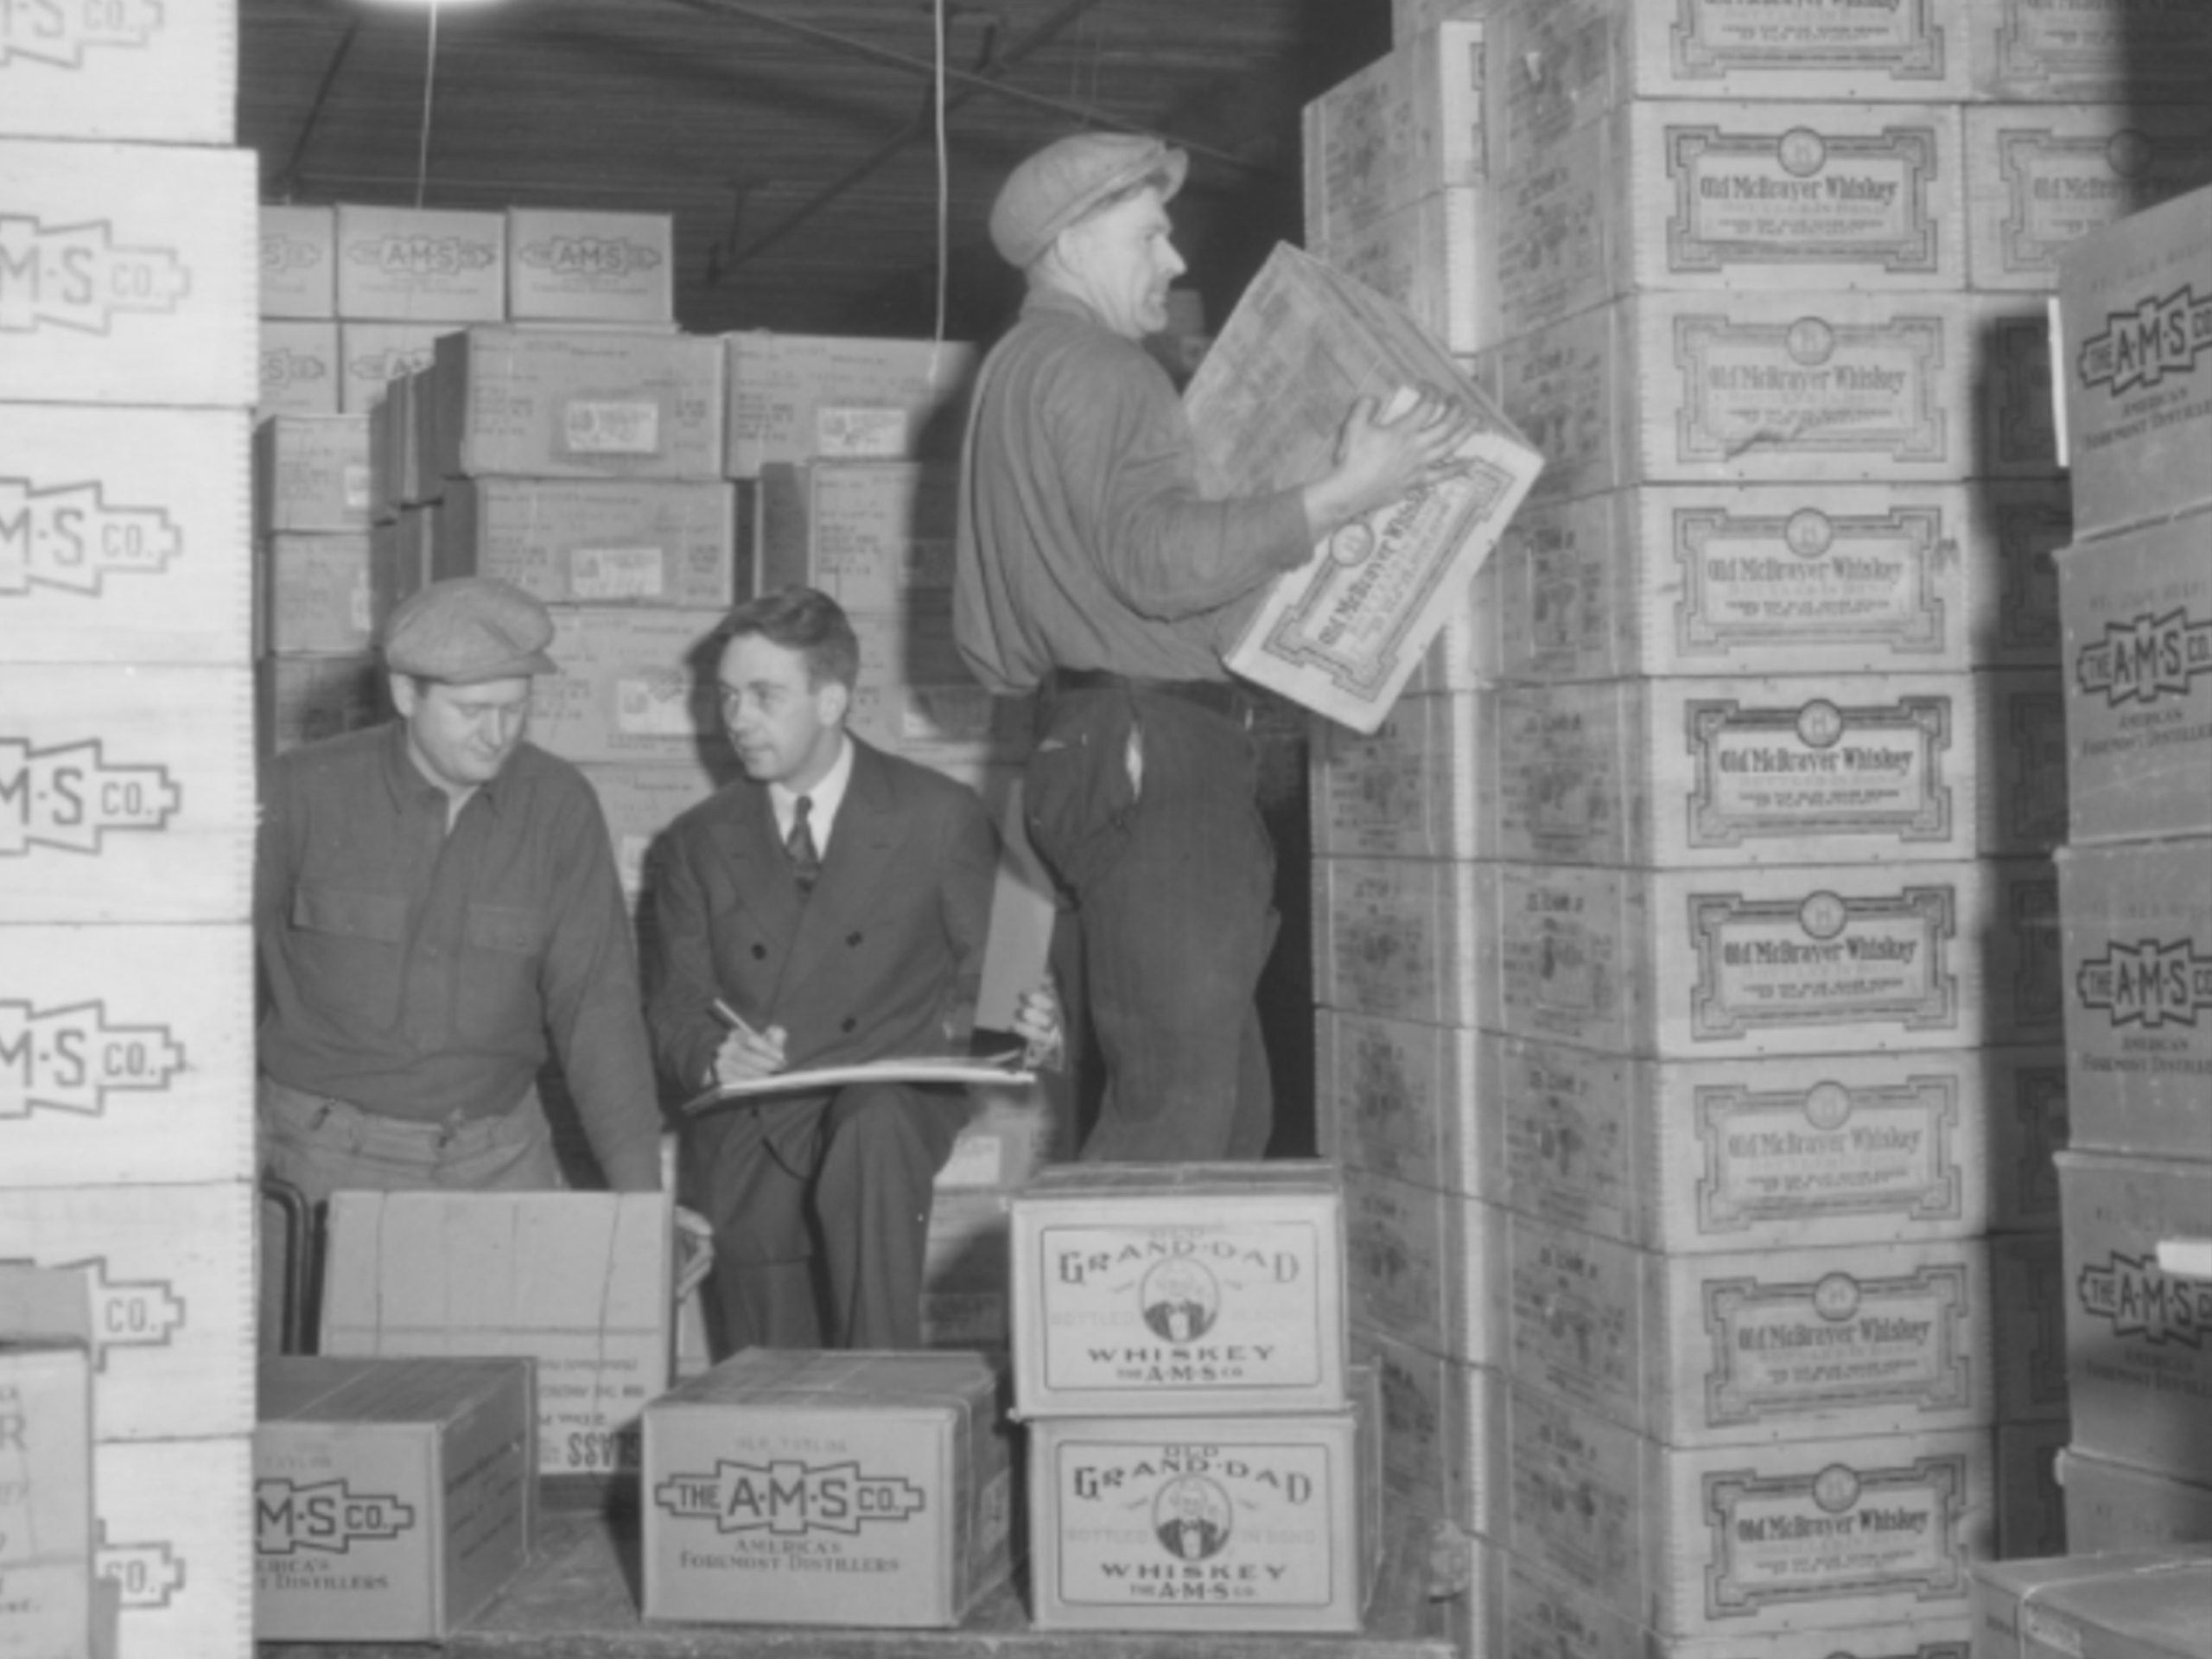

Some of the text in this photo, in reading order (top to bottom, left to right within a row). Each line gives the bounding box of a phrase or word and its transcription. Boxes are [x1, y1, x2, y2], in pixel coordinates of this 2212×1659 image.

[0, 243, 94, 306] M·S
[2114, 307, 2186, 377] A·M·S
[0, 505, 154, 567] M·S CO.
[2113, 630, 2182, 684] A·M·S
[0, 764, 154, 827] M·S CO.
[2117, 959, 2187, 1007] A·M·S
[0, 1027, 156, 1089] M·S CO.
[2120, 1272, 2191, 1326] A·M·S
[1088, 1344, 1275, 1363] WHISKEY
[255, 1497, 336, 1537] M·S
[678, 1484, 721, 1510] THE
[728, 1477, 848, 1517] A·M·S
[1100, 1562, 1287, 1581] WHISKEY
